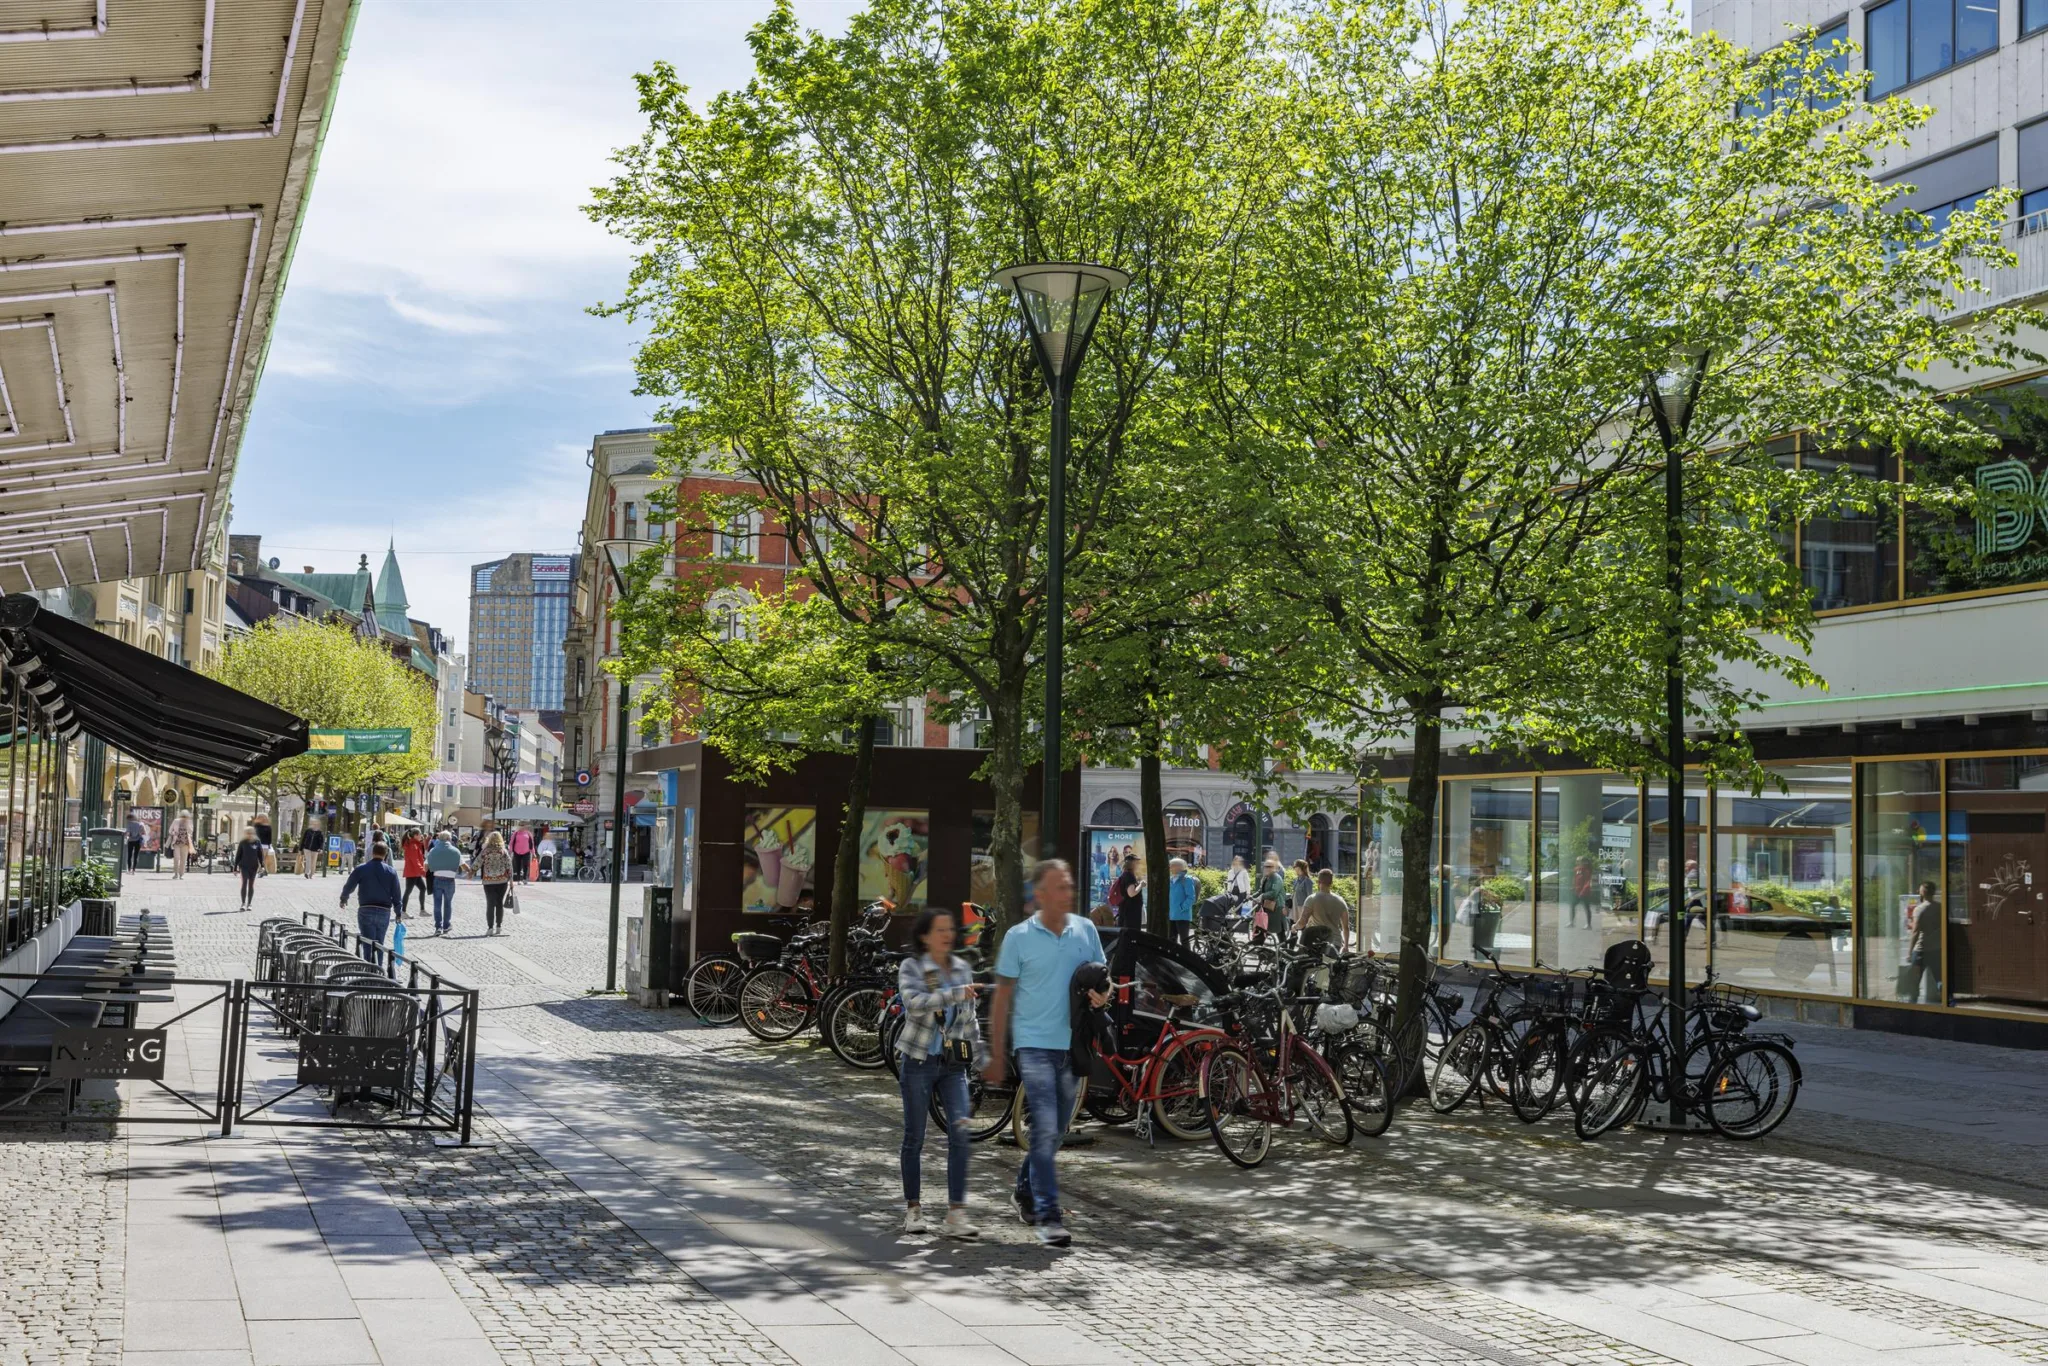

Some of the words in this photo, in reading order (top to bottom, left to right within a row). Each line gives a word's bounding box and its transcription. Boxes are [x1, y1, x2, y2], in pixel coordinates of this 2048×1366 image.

[1165, 812, 1201, 828] Tattoo
[1388, 846, 1404, 857] Poles
[1598, 848, 1626, 860] Polestar
[1388, 867, 1404, 878] Malm
